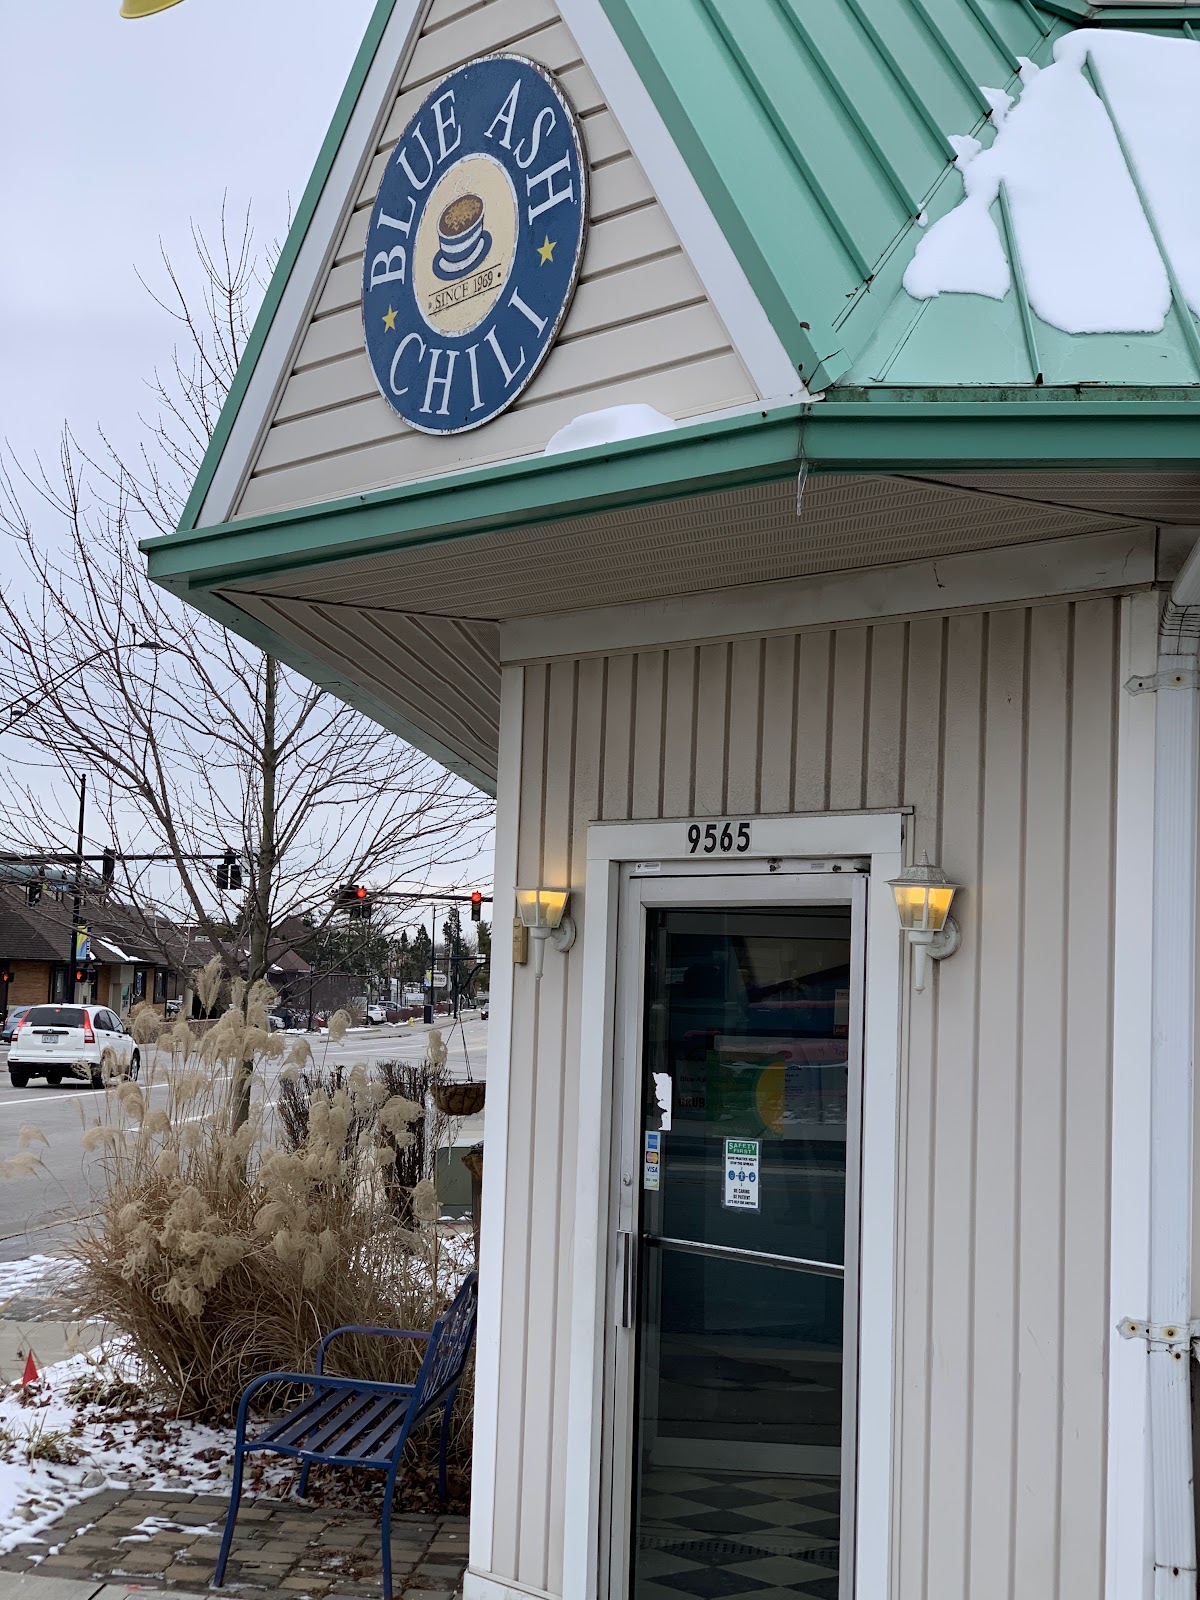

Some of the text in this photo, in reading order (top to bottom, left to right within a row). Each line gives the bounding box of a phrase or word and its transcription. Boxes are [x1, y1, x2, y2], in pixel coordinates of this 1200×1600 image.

[370, 78, 575, 293] BLUE ASH
[435, 270, 493, 309] SINCE 1969
[390, 286, 549, 415] CHILI
[688, 822, 750, 853] 9565
[728, 1142, 756, 1151] SAFETY
